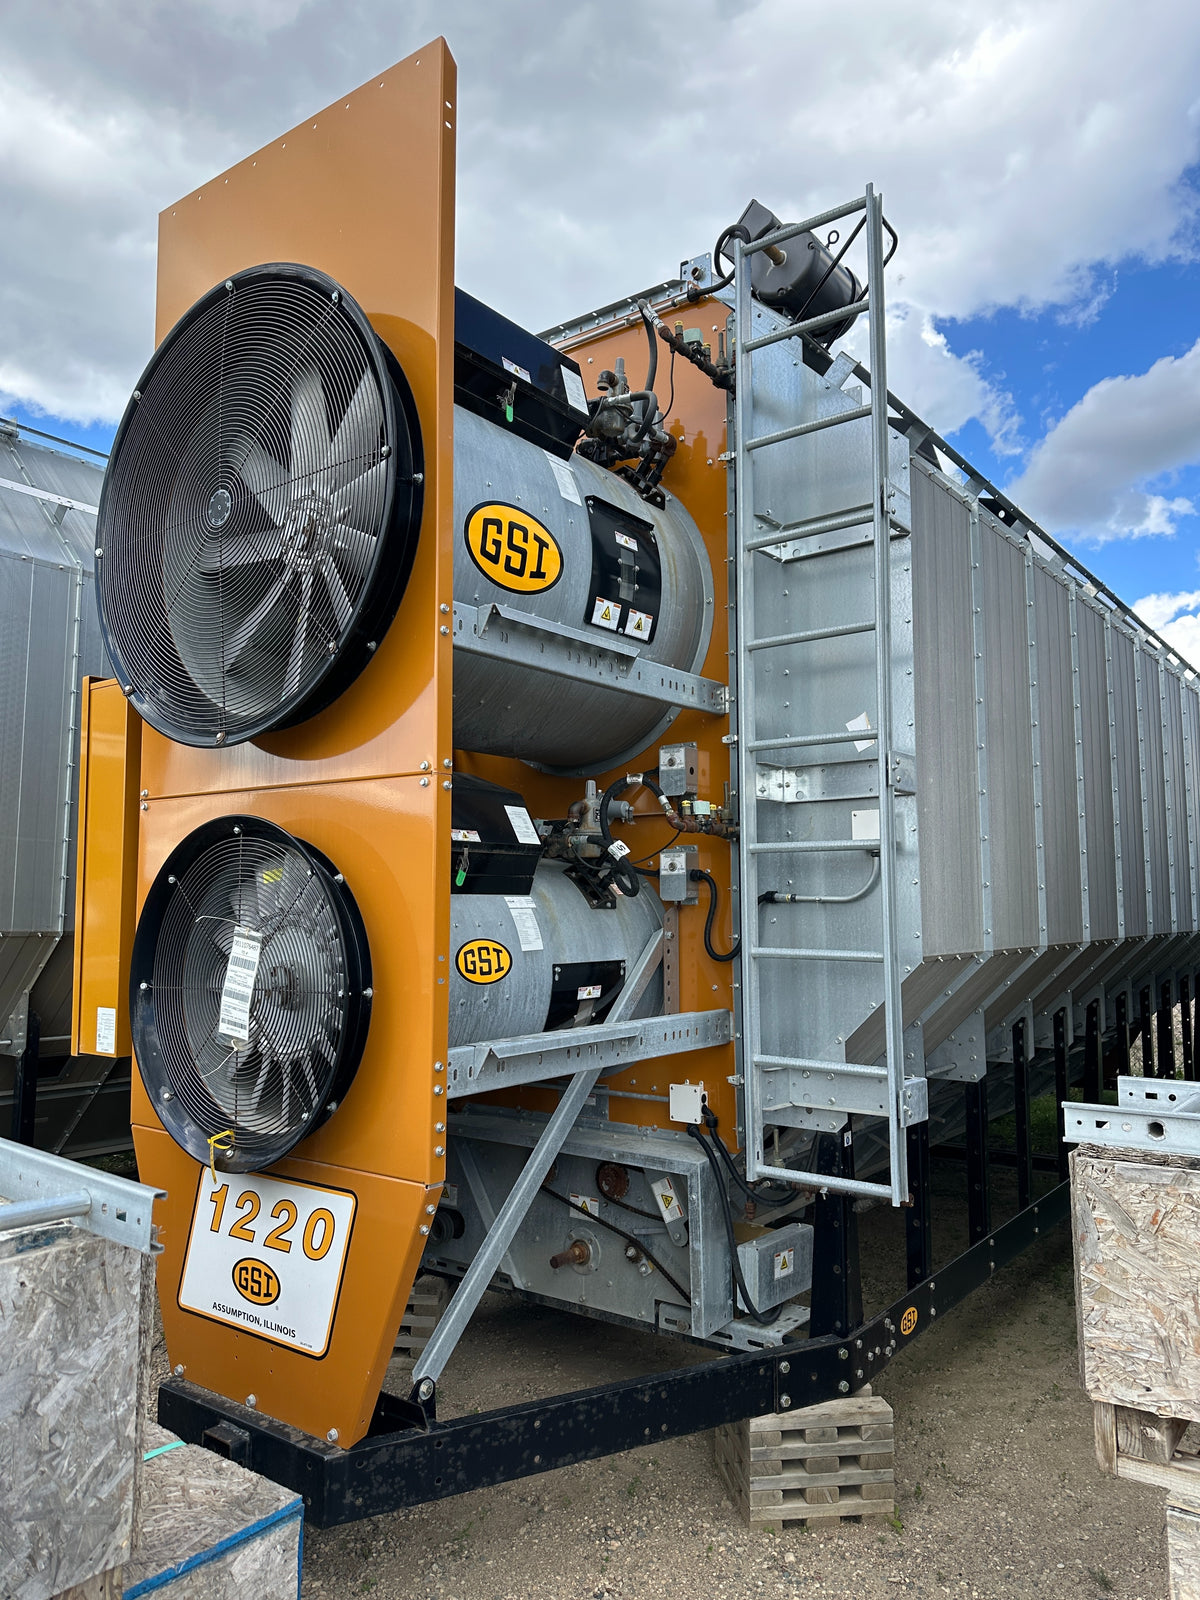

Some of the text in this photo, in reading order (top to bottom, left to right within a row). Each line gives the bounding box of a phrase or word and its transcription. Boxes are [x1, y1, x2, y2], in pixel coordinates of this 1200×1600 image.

[480, 518, 549, 579] GSI
[463, 946, 504, 976] GSI
[210, 1184, 335, 1261] 1220
[238, 1266, 273, 1298] GSI
[212, 1301, 296, 1338] ASSUMPTION, ILLINOIS
[902, 1310, 916, 1332] GSI
